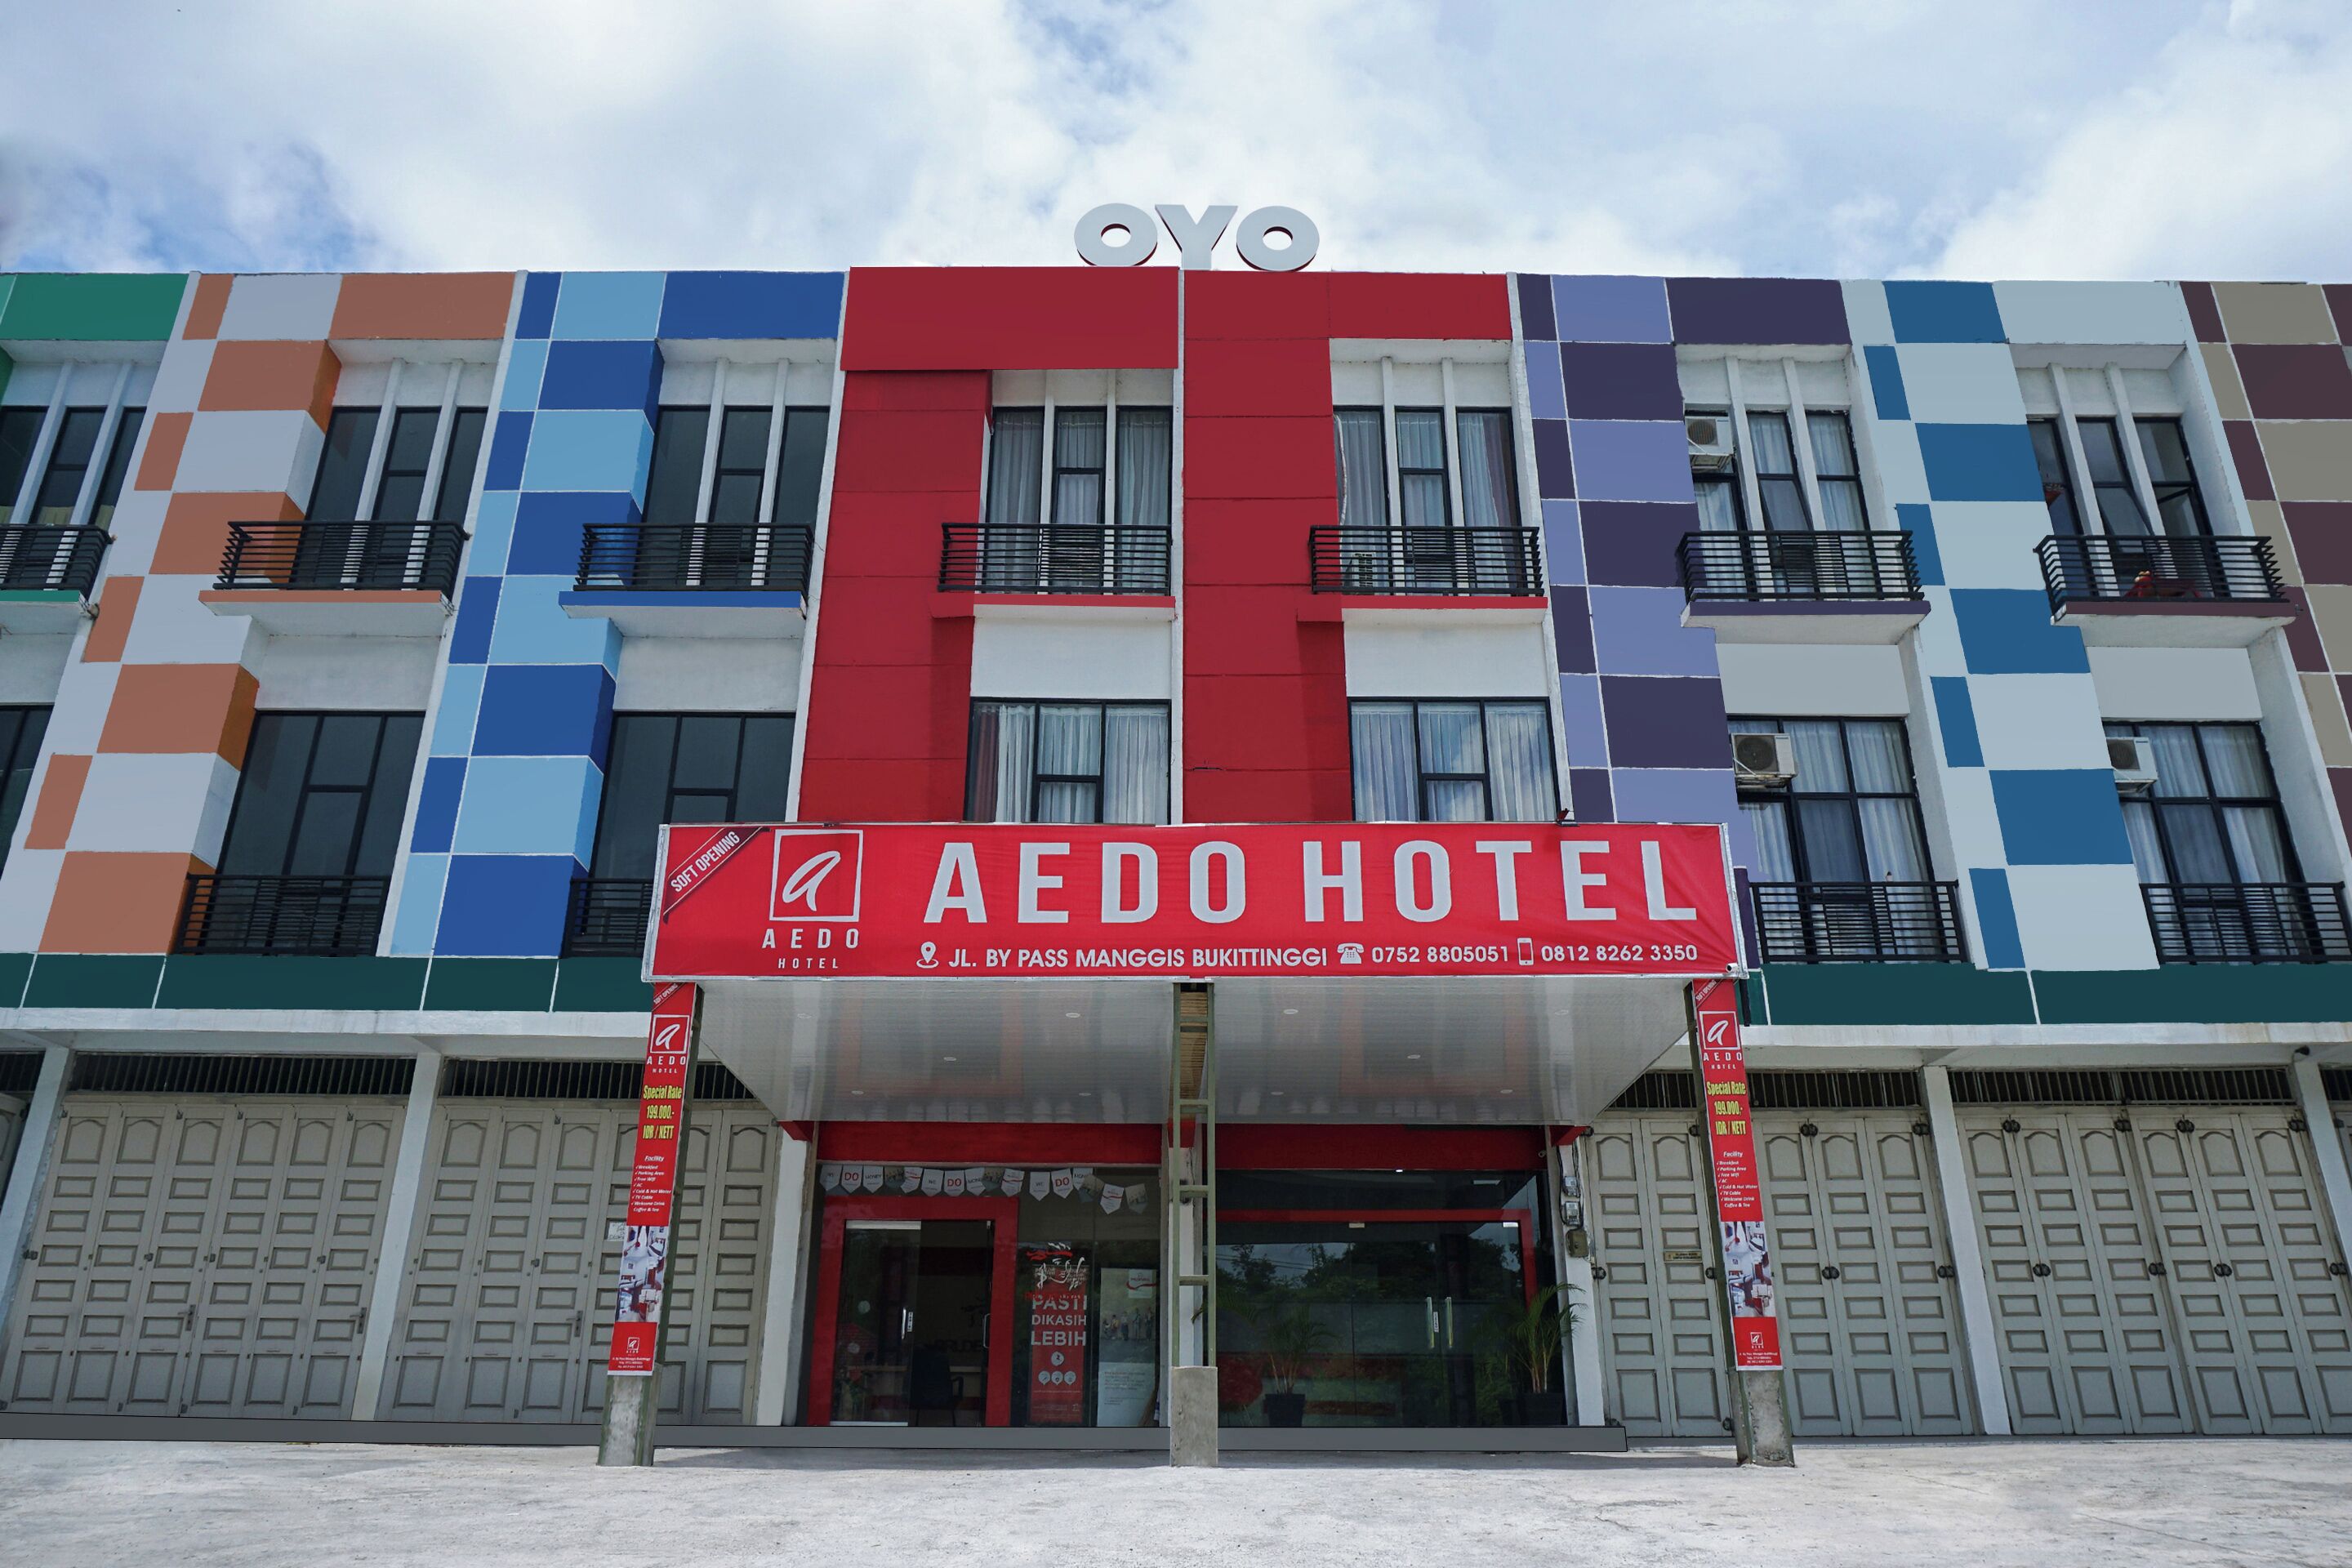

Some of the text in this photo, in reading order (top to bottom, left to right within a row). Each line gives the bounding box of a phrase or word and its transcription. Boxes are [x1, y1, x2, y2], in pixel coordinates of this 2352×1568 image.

[1074, 203, 1320, 272] OYO
[670, 831, 741, 893] SOFT OPENING
[923, 840, 1698, 924] AEDO HOTEL
[761, 928, 859, 949] AEDO
[948, 947, 1327, 968] JL. BY PASS MANGGIS BUKITTINGGI
[1372, 946, 1508, 964] 0752 8805051
[1541, 944, 1698, 962] 0812 8262 3350
[777, 957, 839, 969] HOTEL
[653, 996, 663, 1004] SOFT
[1695, 991, 1705, 1001] SOFT
[646, 1056, 687, 1065] AEDO
[1703, 1052, 1743, 1062] AEDO
[643, 1085, 683, 1100] Special Rate
[1706, 1081, 1746, 1096] Special Rate
[643, 1125, 654, 1139] IDR
[659, 1125, 675, 1139] NETT
[1715, 1120, 1726, 1135] IDR
[1731, 1120, 1746, 1135] NETT
[844, 1172, 859, 1181] DO
[947, 1178, 961, 1187] DO
[1055, 1177, 1070, 1187] DO
[1031, 1294, 1088, 1311] PASTI
[1031, 1314, 1087, 1326] DIKASIH
[1031, 1330, 1087, 1347] LEBIH
